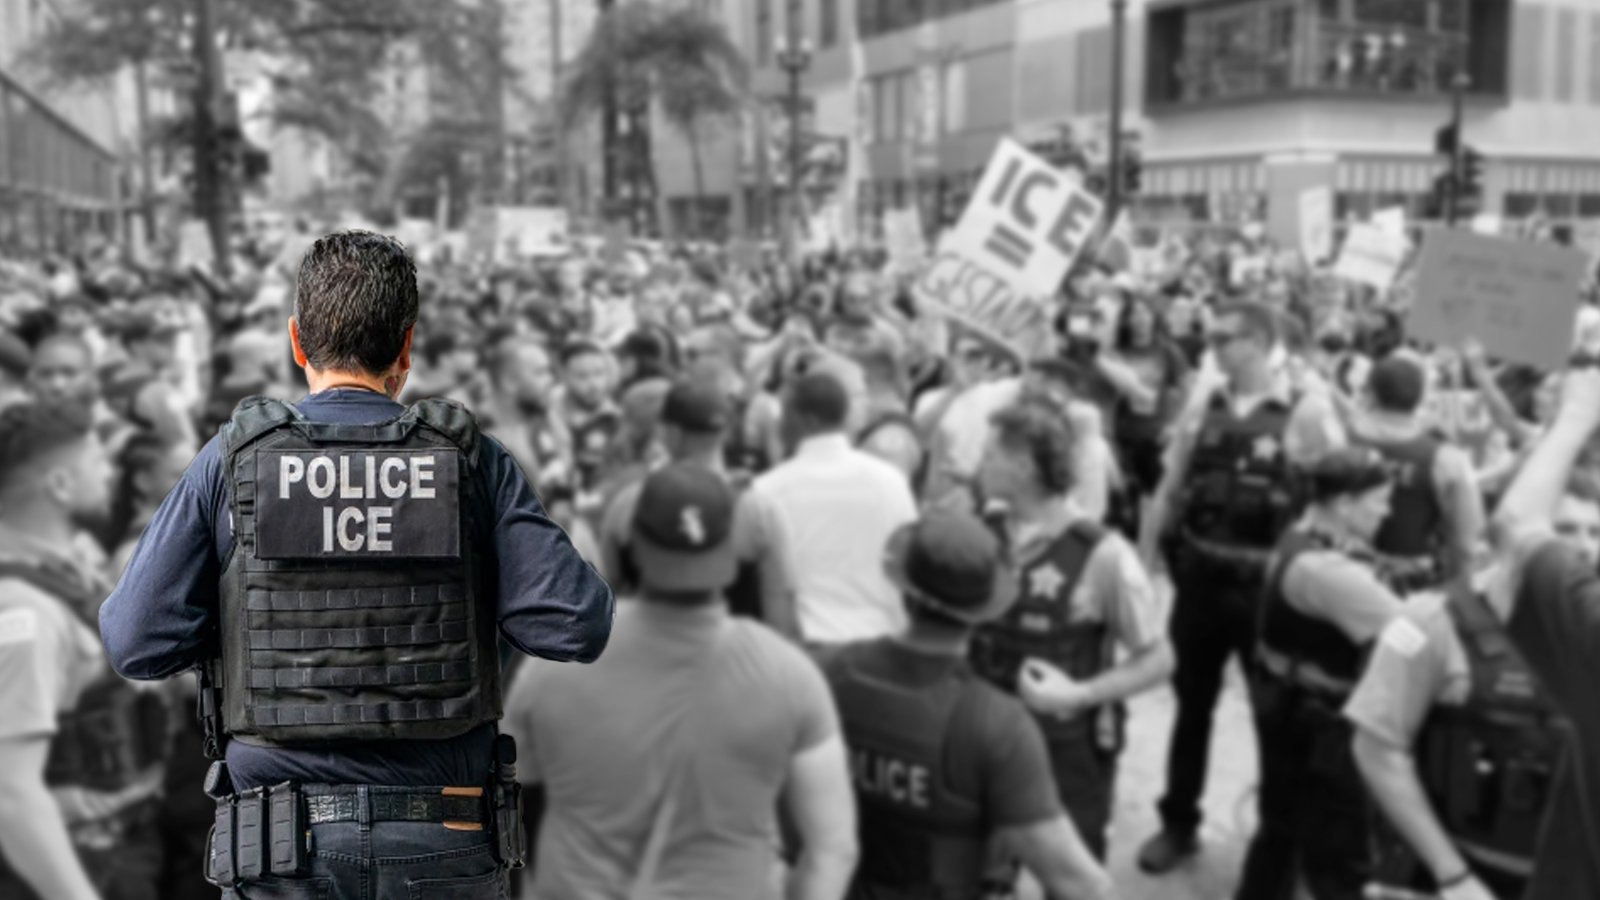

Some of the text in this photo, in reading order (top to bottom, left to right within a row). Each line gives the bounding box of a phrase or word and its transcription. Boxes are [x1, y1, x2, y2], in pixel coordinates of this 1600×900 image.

[990, 157, 1096, 256] ICE
[919, 252, 1047, 341] GESTAP
[279, 455, 436, 499] POLICE
[322, 506, 393, 552] ICE
[856, 751, 930, 808] LICE
